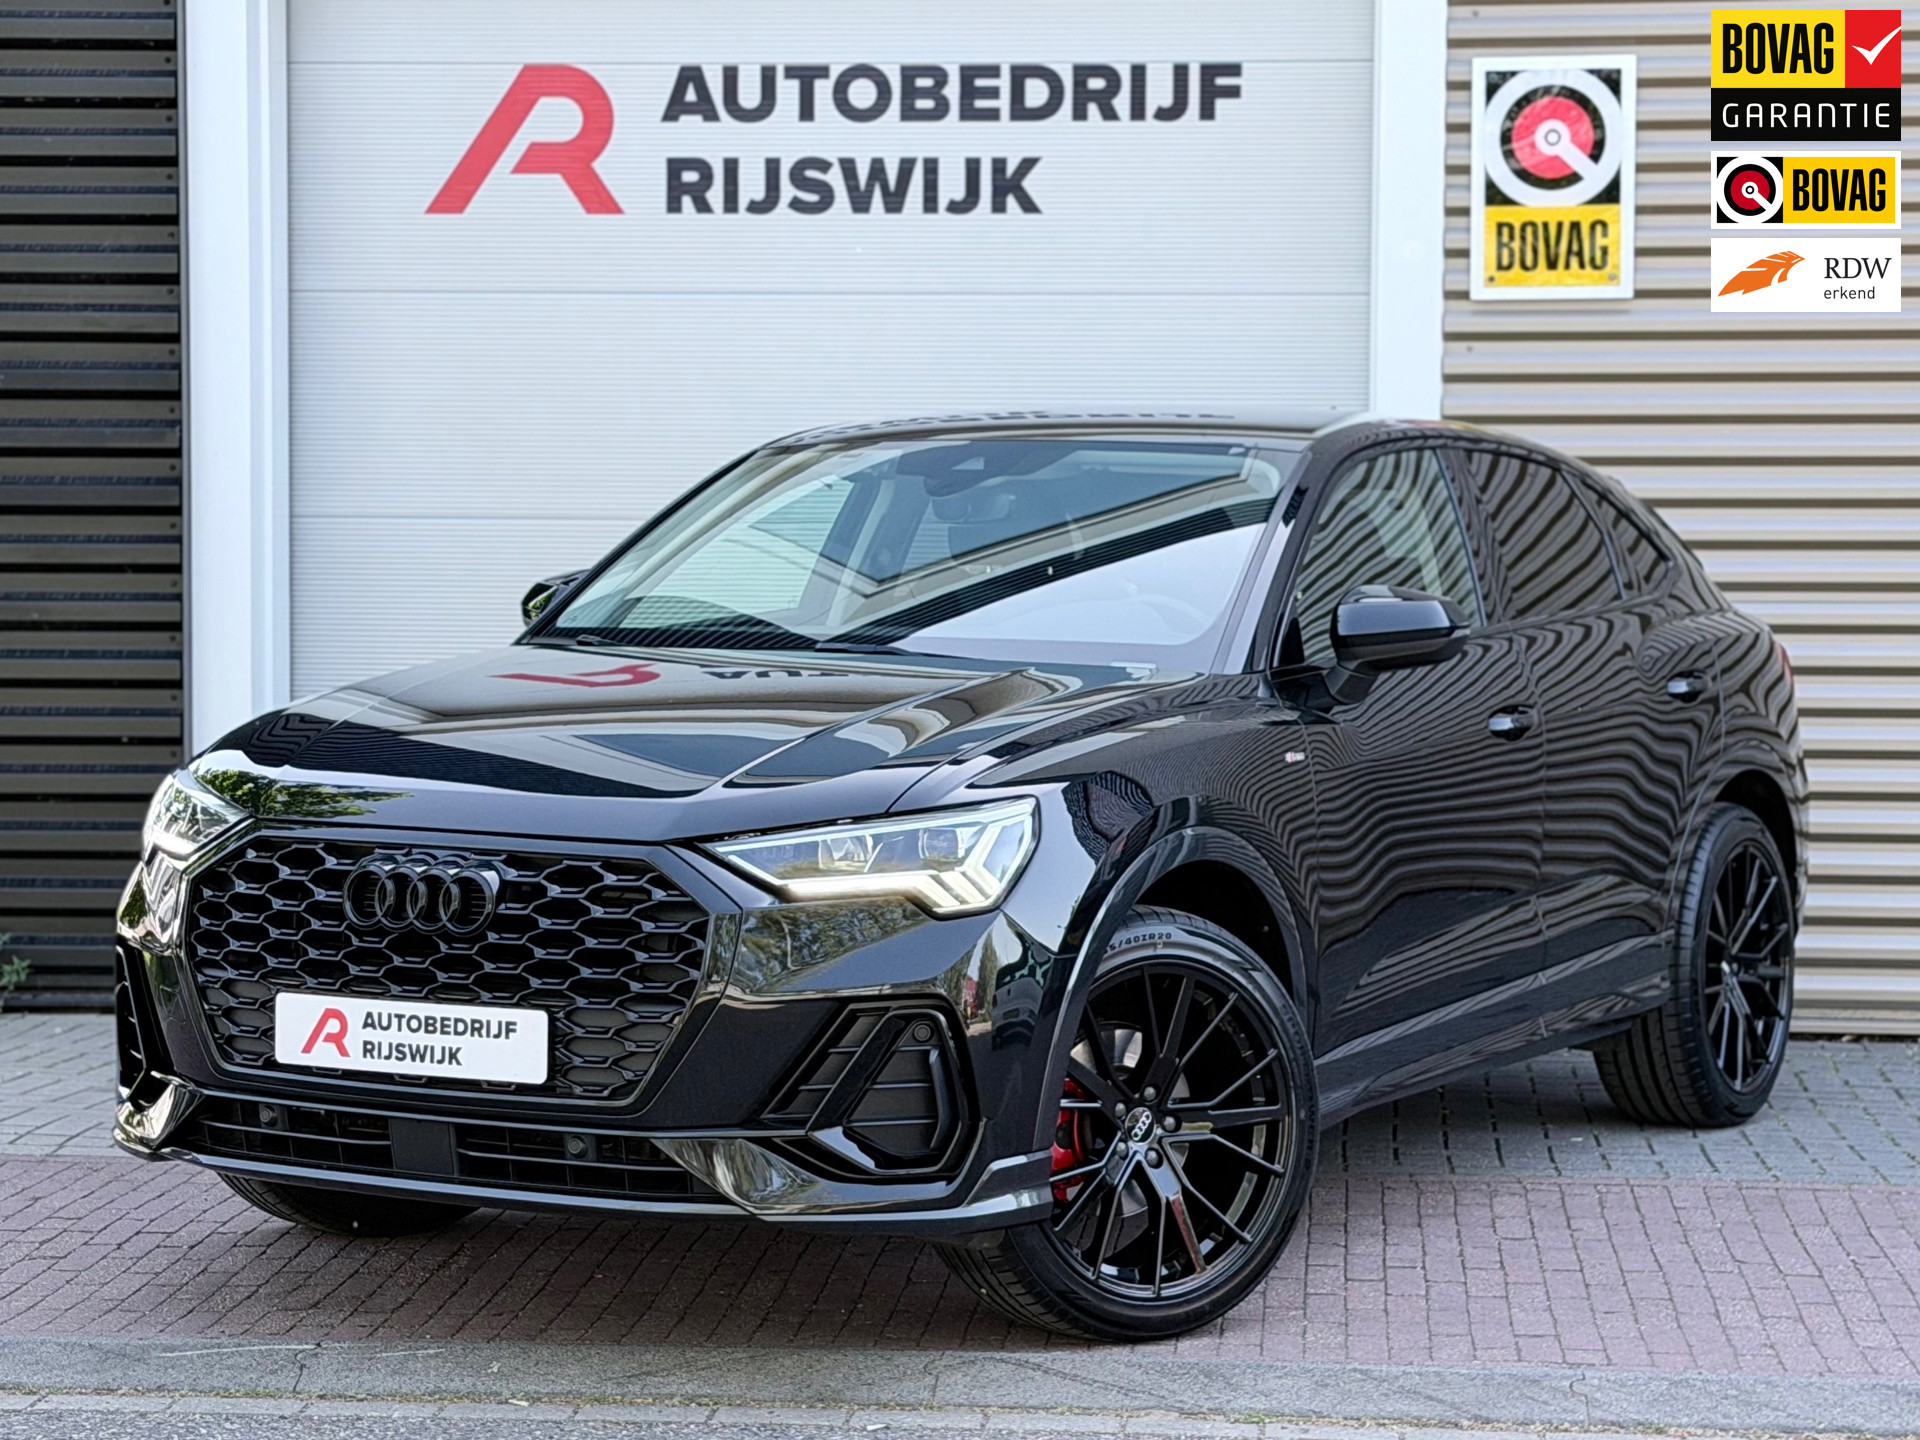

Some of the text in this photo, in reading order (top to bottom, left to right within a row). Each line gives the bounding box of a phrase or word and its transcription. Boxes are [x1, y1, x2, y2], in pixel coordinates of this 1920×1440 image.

[661, 62, 1243, 123] AUTOBEDRIJF
[665, 156, 1043, 215] RIJSWIJK
[1494, 219, 1610, 273] BOVAG
[1105, 931, 1173, 953] 5/40ZR20
[361, 1010, 518, 1041] AUTOBEDRIJF
[361, 1039, 463, 1067] RIJSWIJK
